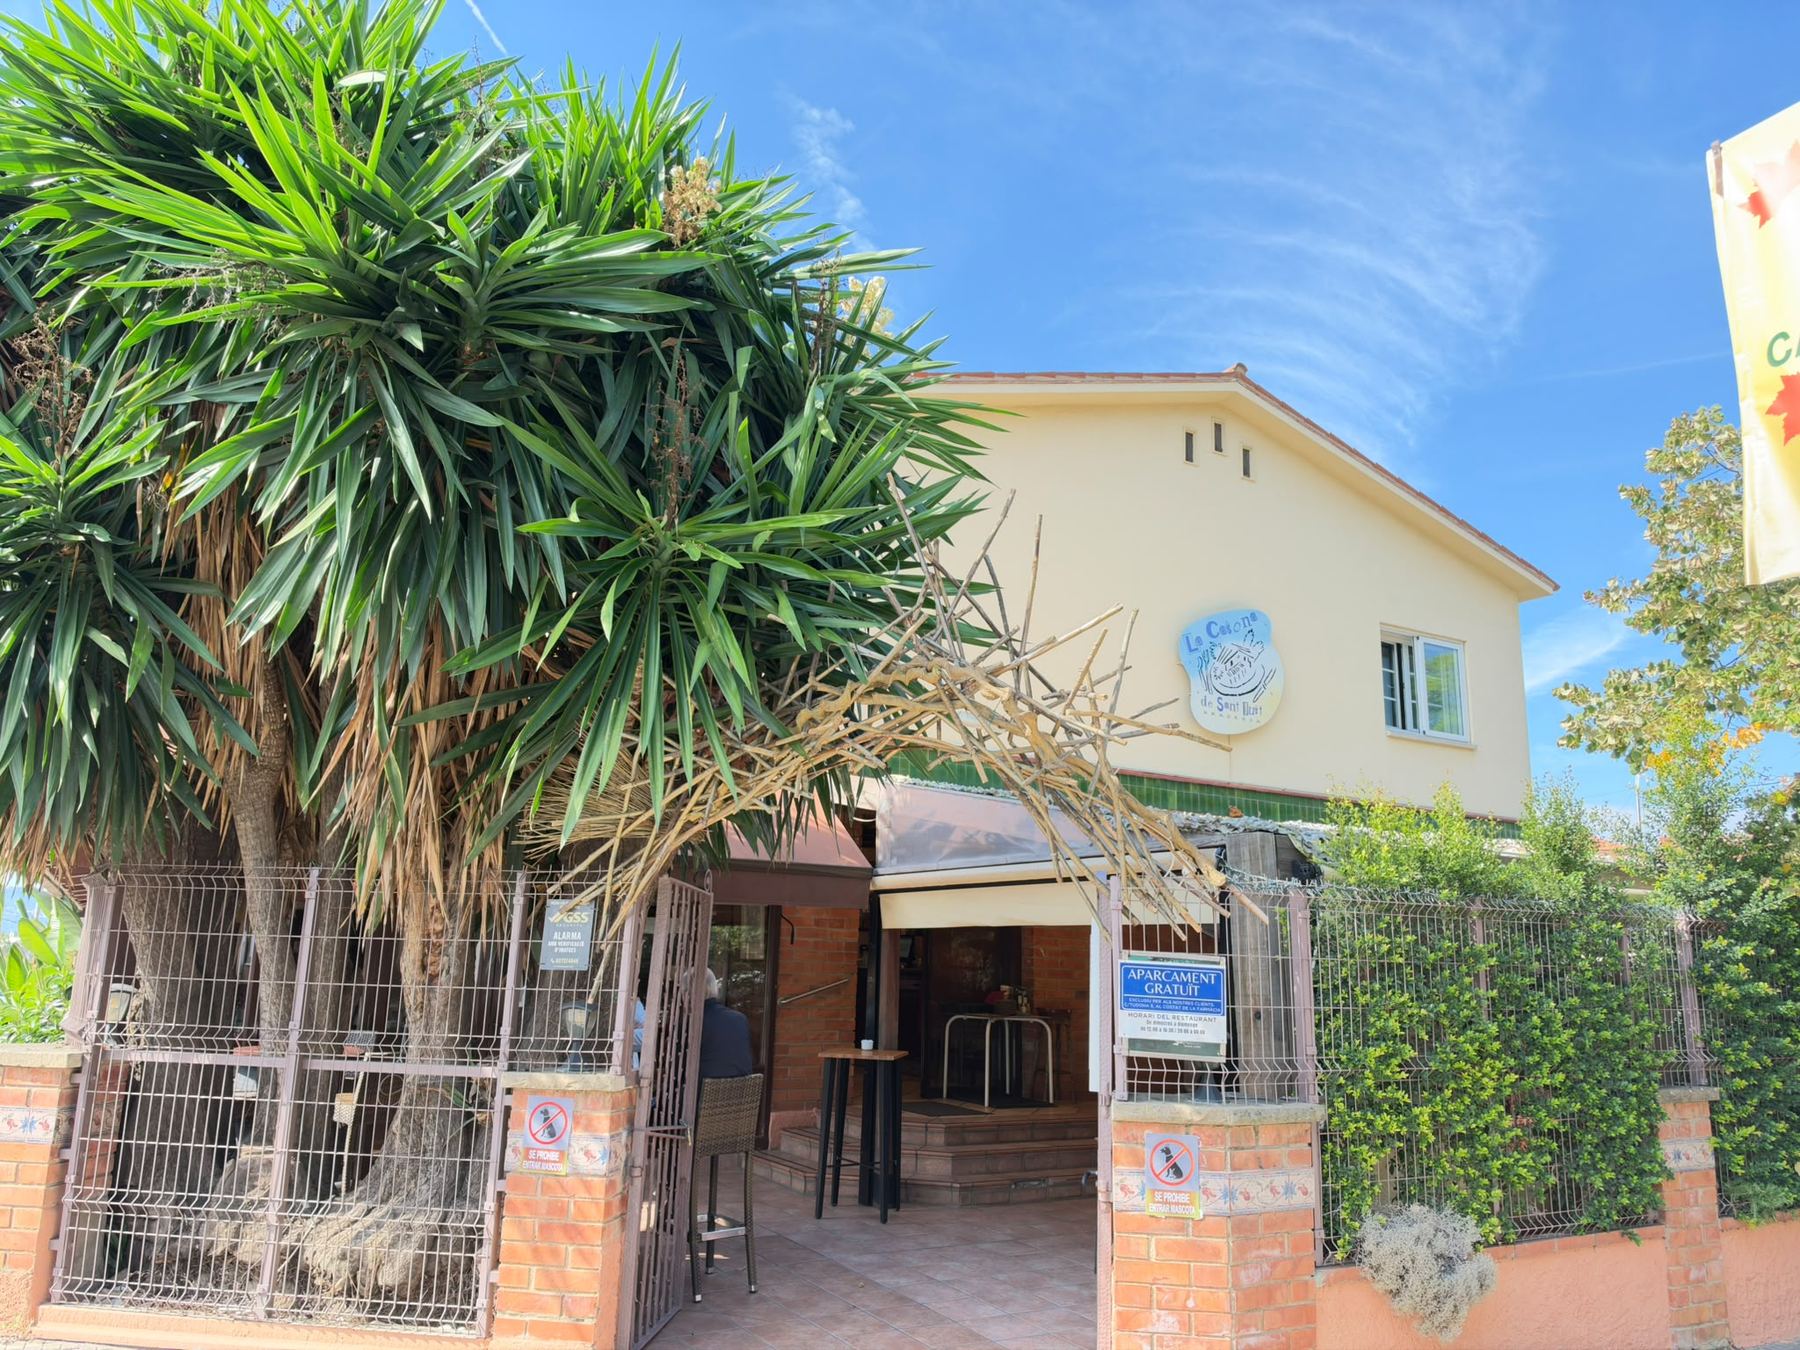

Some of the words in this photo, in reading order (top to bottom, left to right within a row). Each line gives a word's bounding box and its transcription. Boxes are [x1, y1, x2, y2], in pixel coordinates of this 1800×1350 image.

[1185, 634, 1203, 653] La
[1206, 612, 1258, 639] Casona
[1201, 696, 1213, 708] de
[1216, 696, 1239, 712] Sant
[562, 912, 590, 923] GSS
[553, 931, 582, 940] ALARMA
[1127, 968, 1217, 985] APARCAMENT
[1144, 982, 1200, 996] GRATUÏT
[1172, 1015, 1217, 1023] RESTAURANT
[537, 1150, 560, 1160] PROHIBE
[1154, 1191, 1162, 1201] SE
[1163, 1191, 1190, 1203] PROHIBE
[1149, 1203, 1171, 1212] ENTRAR
